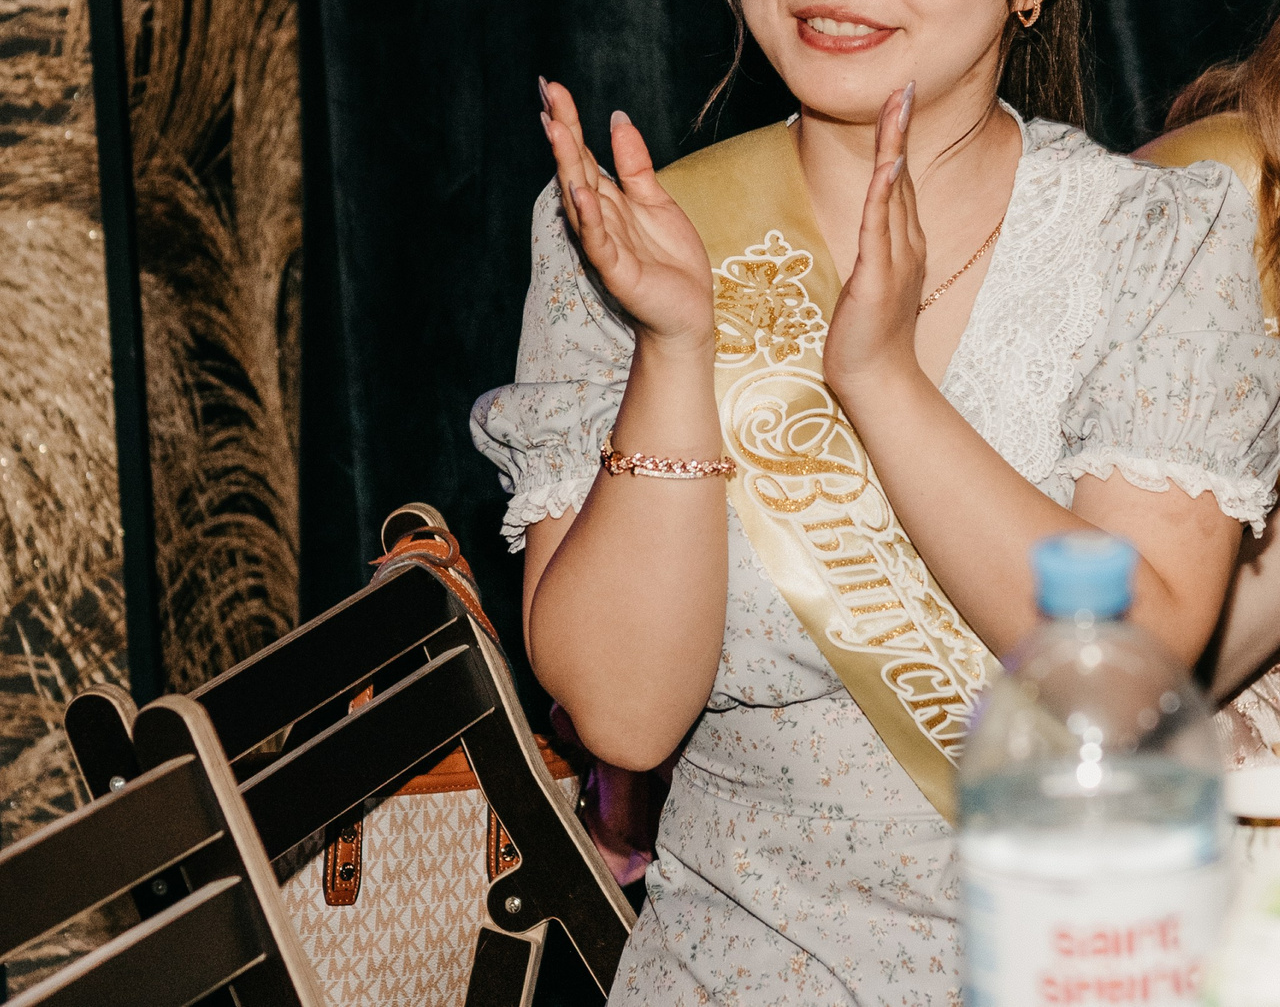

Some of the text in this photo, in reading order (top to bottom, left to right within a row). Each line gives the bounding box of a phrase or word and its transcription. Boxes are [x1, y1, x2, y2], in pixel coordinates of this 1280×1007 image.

[718, 364, 970, 770] Выпуск
[409, 791, 474, 810] MK MK
[390, 803, 486, 835] MK MK MK
[367, 830, 468, 860] MK MK MK
[382, 852, 481, 884] MK MK MK
[286, 878, 461, 912] MK MK MK MK
[300, 900, 475, 935] MK MK MK MK MK
[313, 926, 455, 958] MK MK MK MK
[326, 948, 466, 981] MK MK MK MK
[340, 970, 468, 1004] MK MK MK MK
